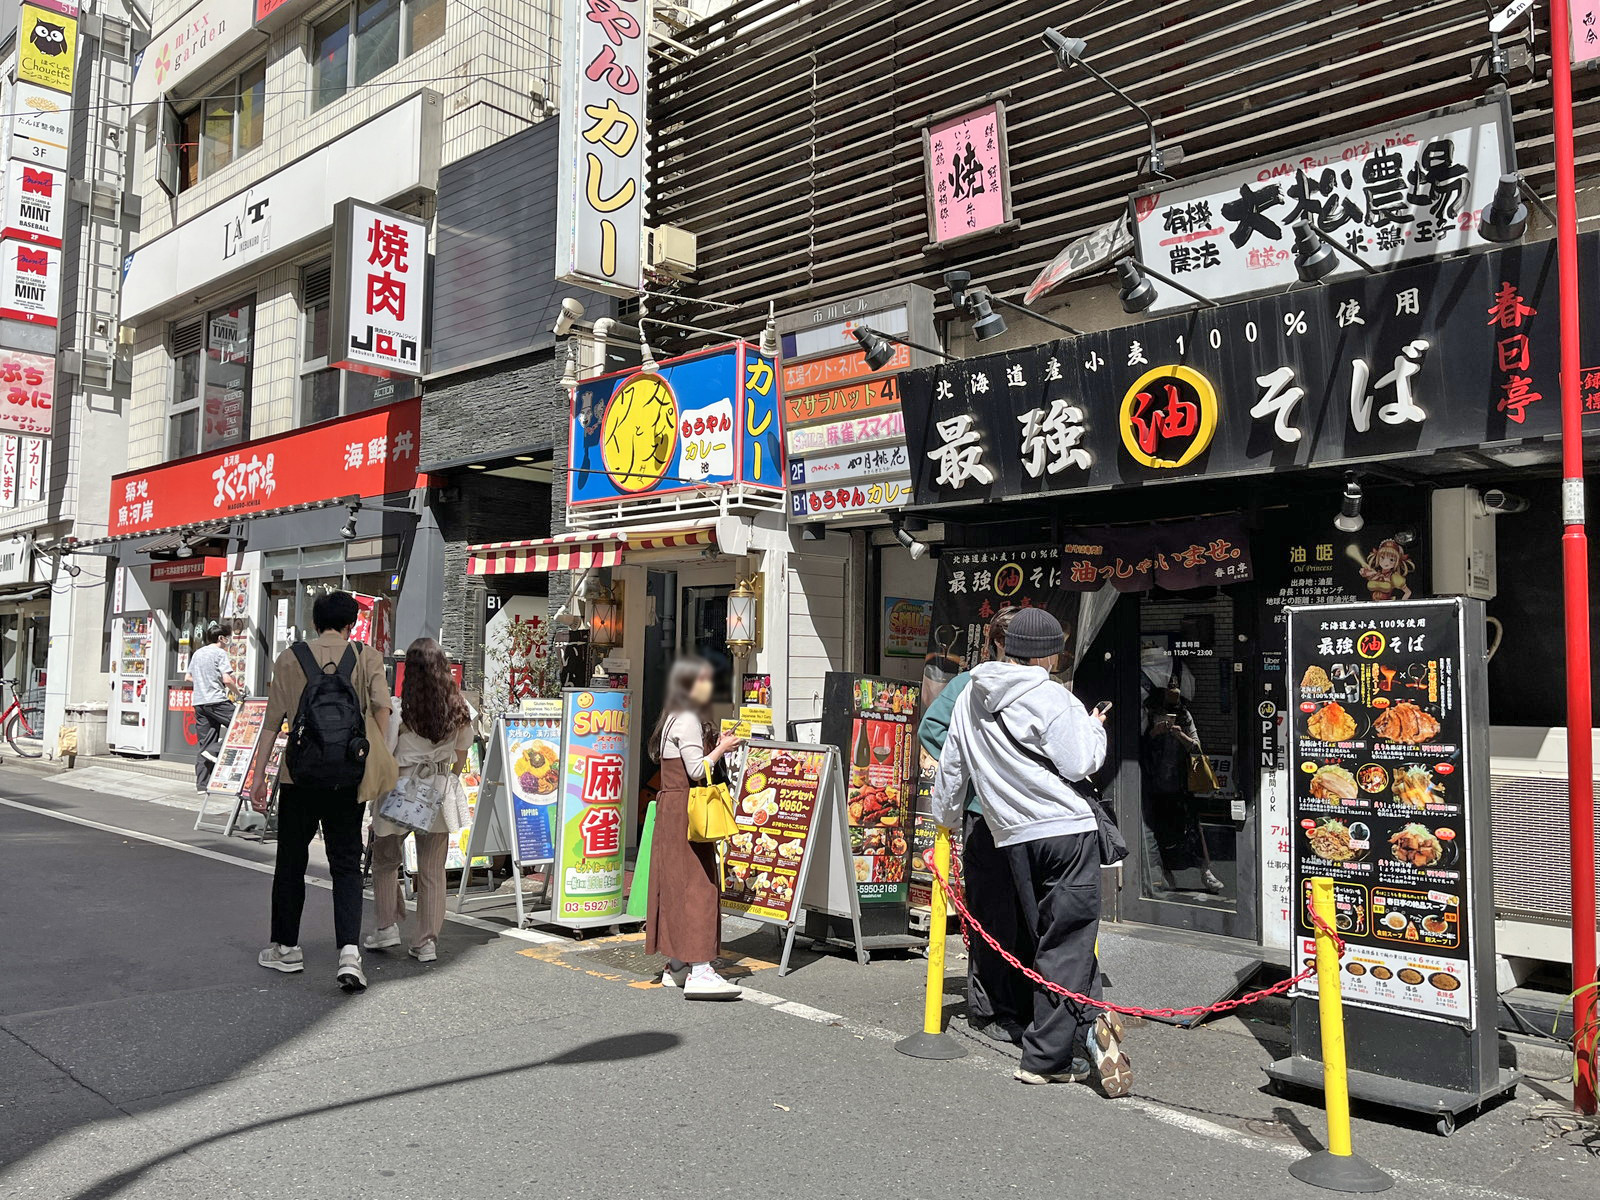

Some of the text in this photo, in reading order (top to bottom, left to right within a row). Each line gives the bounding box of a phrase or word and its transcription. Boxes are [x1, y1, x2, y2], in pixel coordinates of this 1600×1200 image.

[61, 4, 75, 14] 5F
[174, 12, 209, 50] mixx
[174, 19, 227, 71] garden
[22, 57, 70, 80] Chouette
[32, 147, 47, 157] 3F
[19, 204, 51, 223] MINT
[1162, 201, 1213, 234] 有機
[19, 220, 50, 232] BASEBALL
[367, 218, 409, 321] 焼肉
[1169, 241, 1221, 275] 農法
[15, 283, 46, 301] MINT
[813, 298, 868, 323] 市川ビル
[1487, 281, 1543, 424] 春日亭
[7, 387, 51, 409] みに
[789, 383, 877, 418] マサラハット
[19, 423, 51, 433] ラウンジ
[681, 412, 731, 438] もうやん
[745, 357, 774, 481] カレー
[826, 422, 856, 445] 麻雀
[343, 429, 414, 472] 海鮮丼
[685, 440, 726, 461] カレー
[701, 462, 709, 473] 池
[791, 462, 804, 480] 2F
[125, 479, 148, 502] 築地
[212, 453, 276, 507] まぐろ市場
[793, 494, 806, 511] B1
[809, 482, 914, 511] もうやん カレー
[117, 500, 154, 527] 魚河岸
[1290, 543, 1334, 563] 油姫
[1214, 562, 1248, 578] 春日亭
[487, 596, 500, 609] B1
[1320, 618, 1426, 631] 北海道産小麦100%使用
[581, 754, 625, 858] 麻雀
[780, 789, 815, 801] ランチセット
